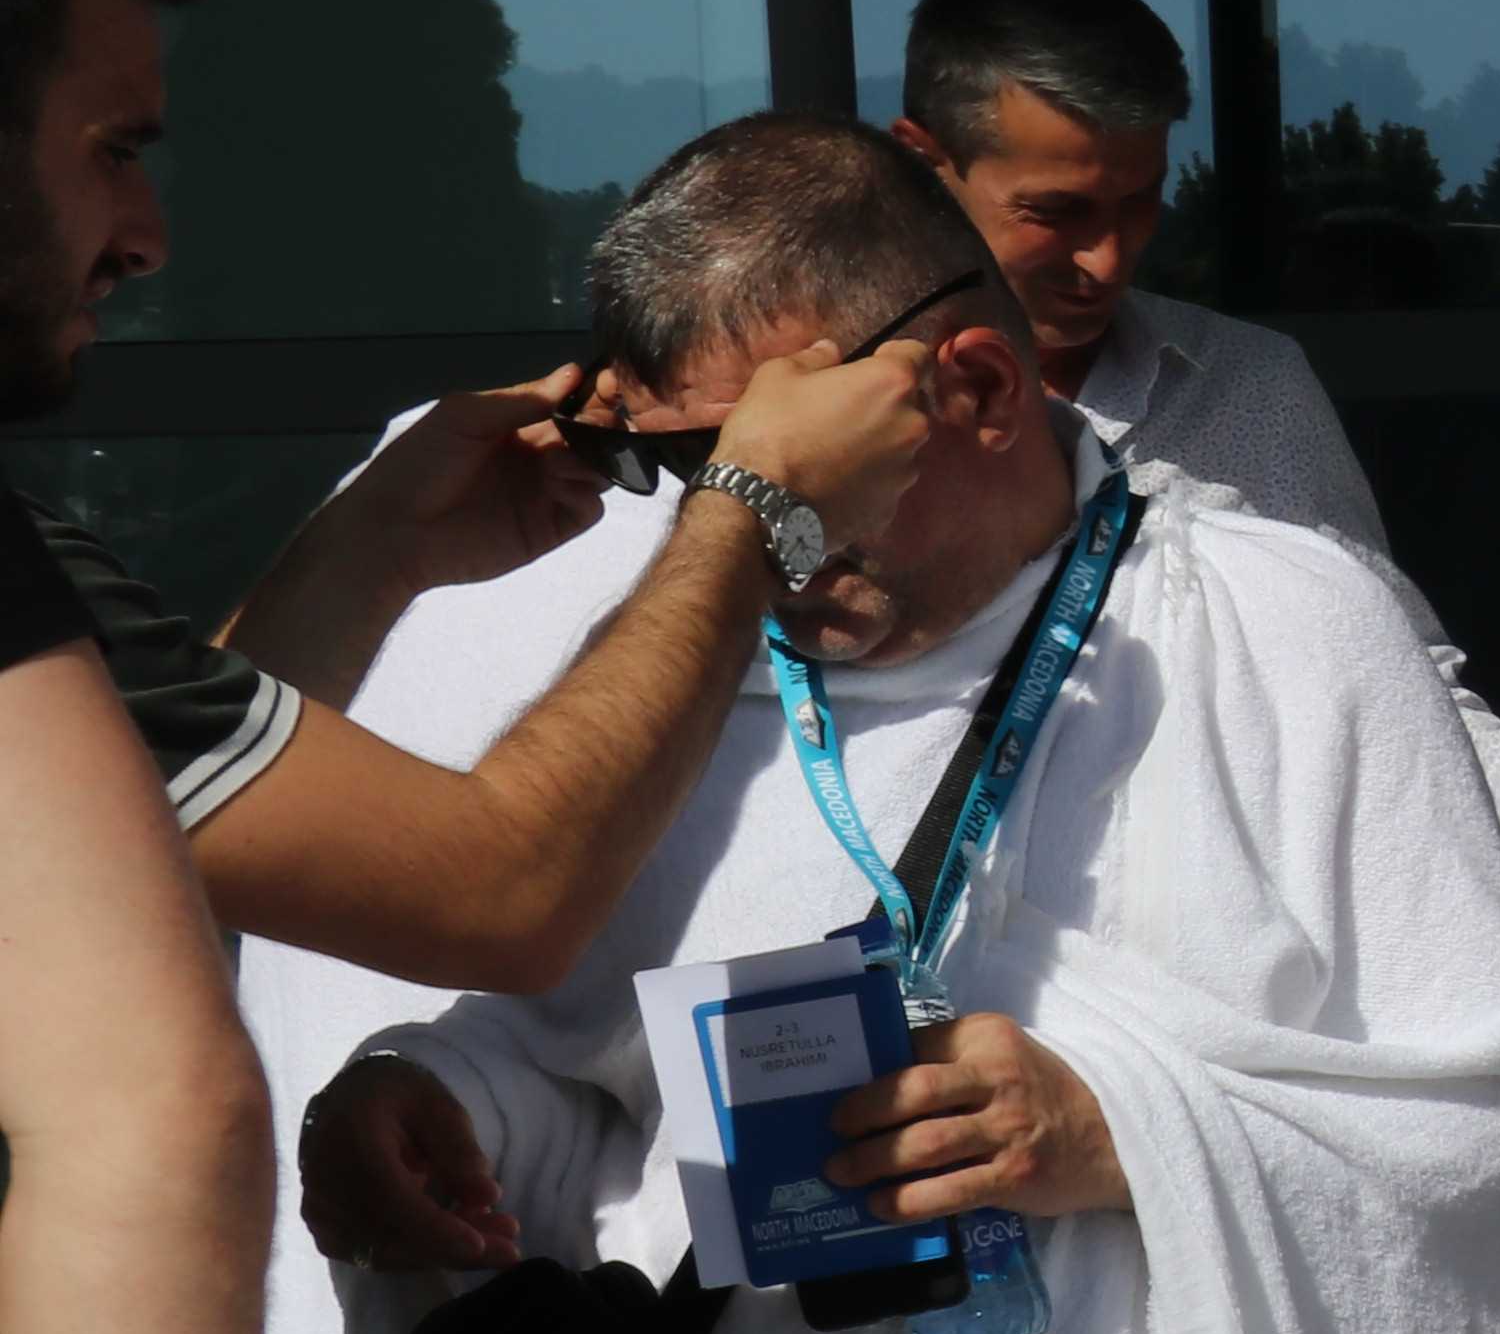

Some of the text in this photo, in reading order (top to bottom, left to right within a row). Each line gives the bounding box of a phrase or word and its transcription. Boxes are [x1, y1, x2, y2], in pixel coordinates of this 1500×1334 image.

[1011, 560, 1097, 723] NORTH MACEDONIA
[810, 756, 906, 900] NORTH MACEDONIA
[960, 787, 999, 844] NORT
[752, 1206, 861, 1242] NORTH MACEDONIA
